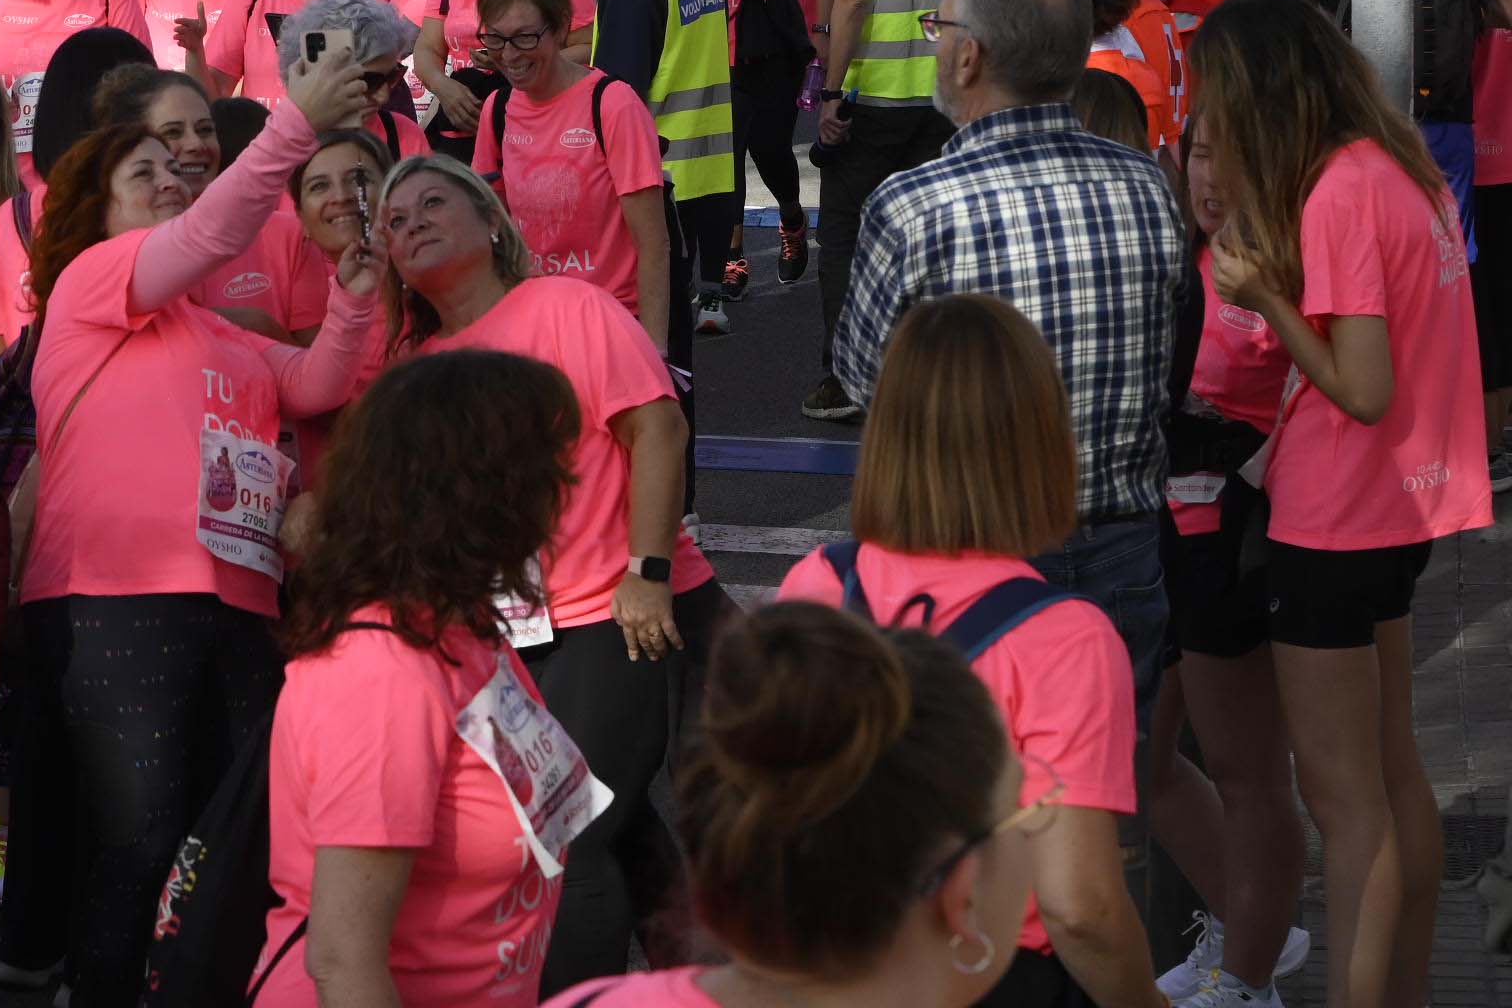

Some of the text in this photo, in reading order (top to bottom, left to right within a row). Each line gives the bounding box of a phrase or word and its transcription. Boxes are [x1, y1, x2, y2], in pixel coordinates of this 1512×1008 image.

[201, 368, 234, 404] TU
[1402, 467, 1451, 492] OYSHO
[240, 487, 272, 514] 016
[242, 511, 269, 530] 27092
[206, 537, 242, 555] OYSHO
